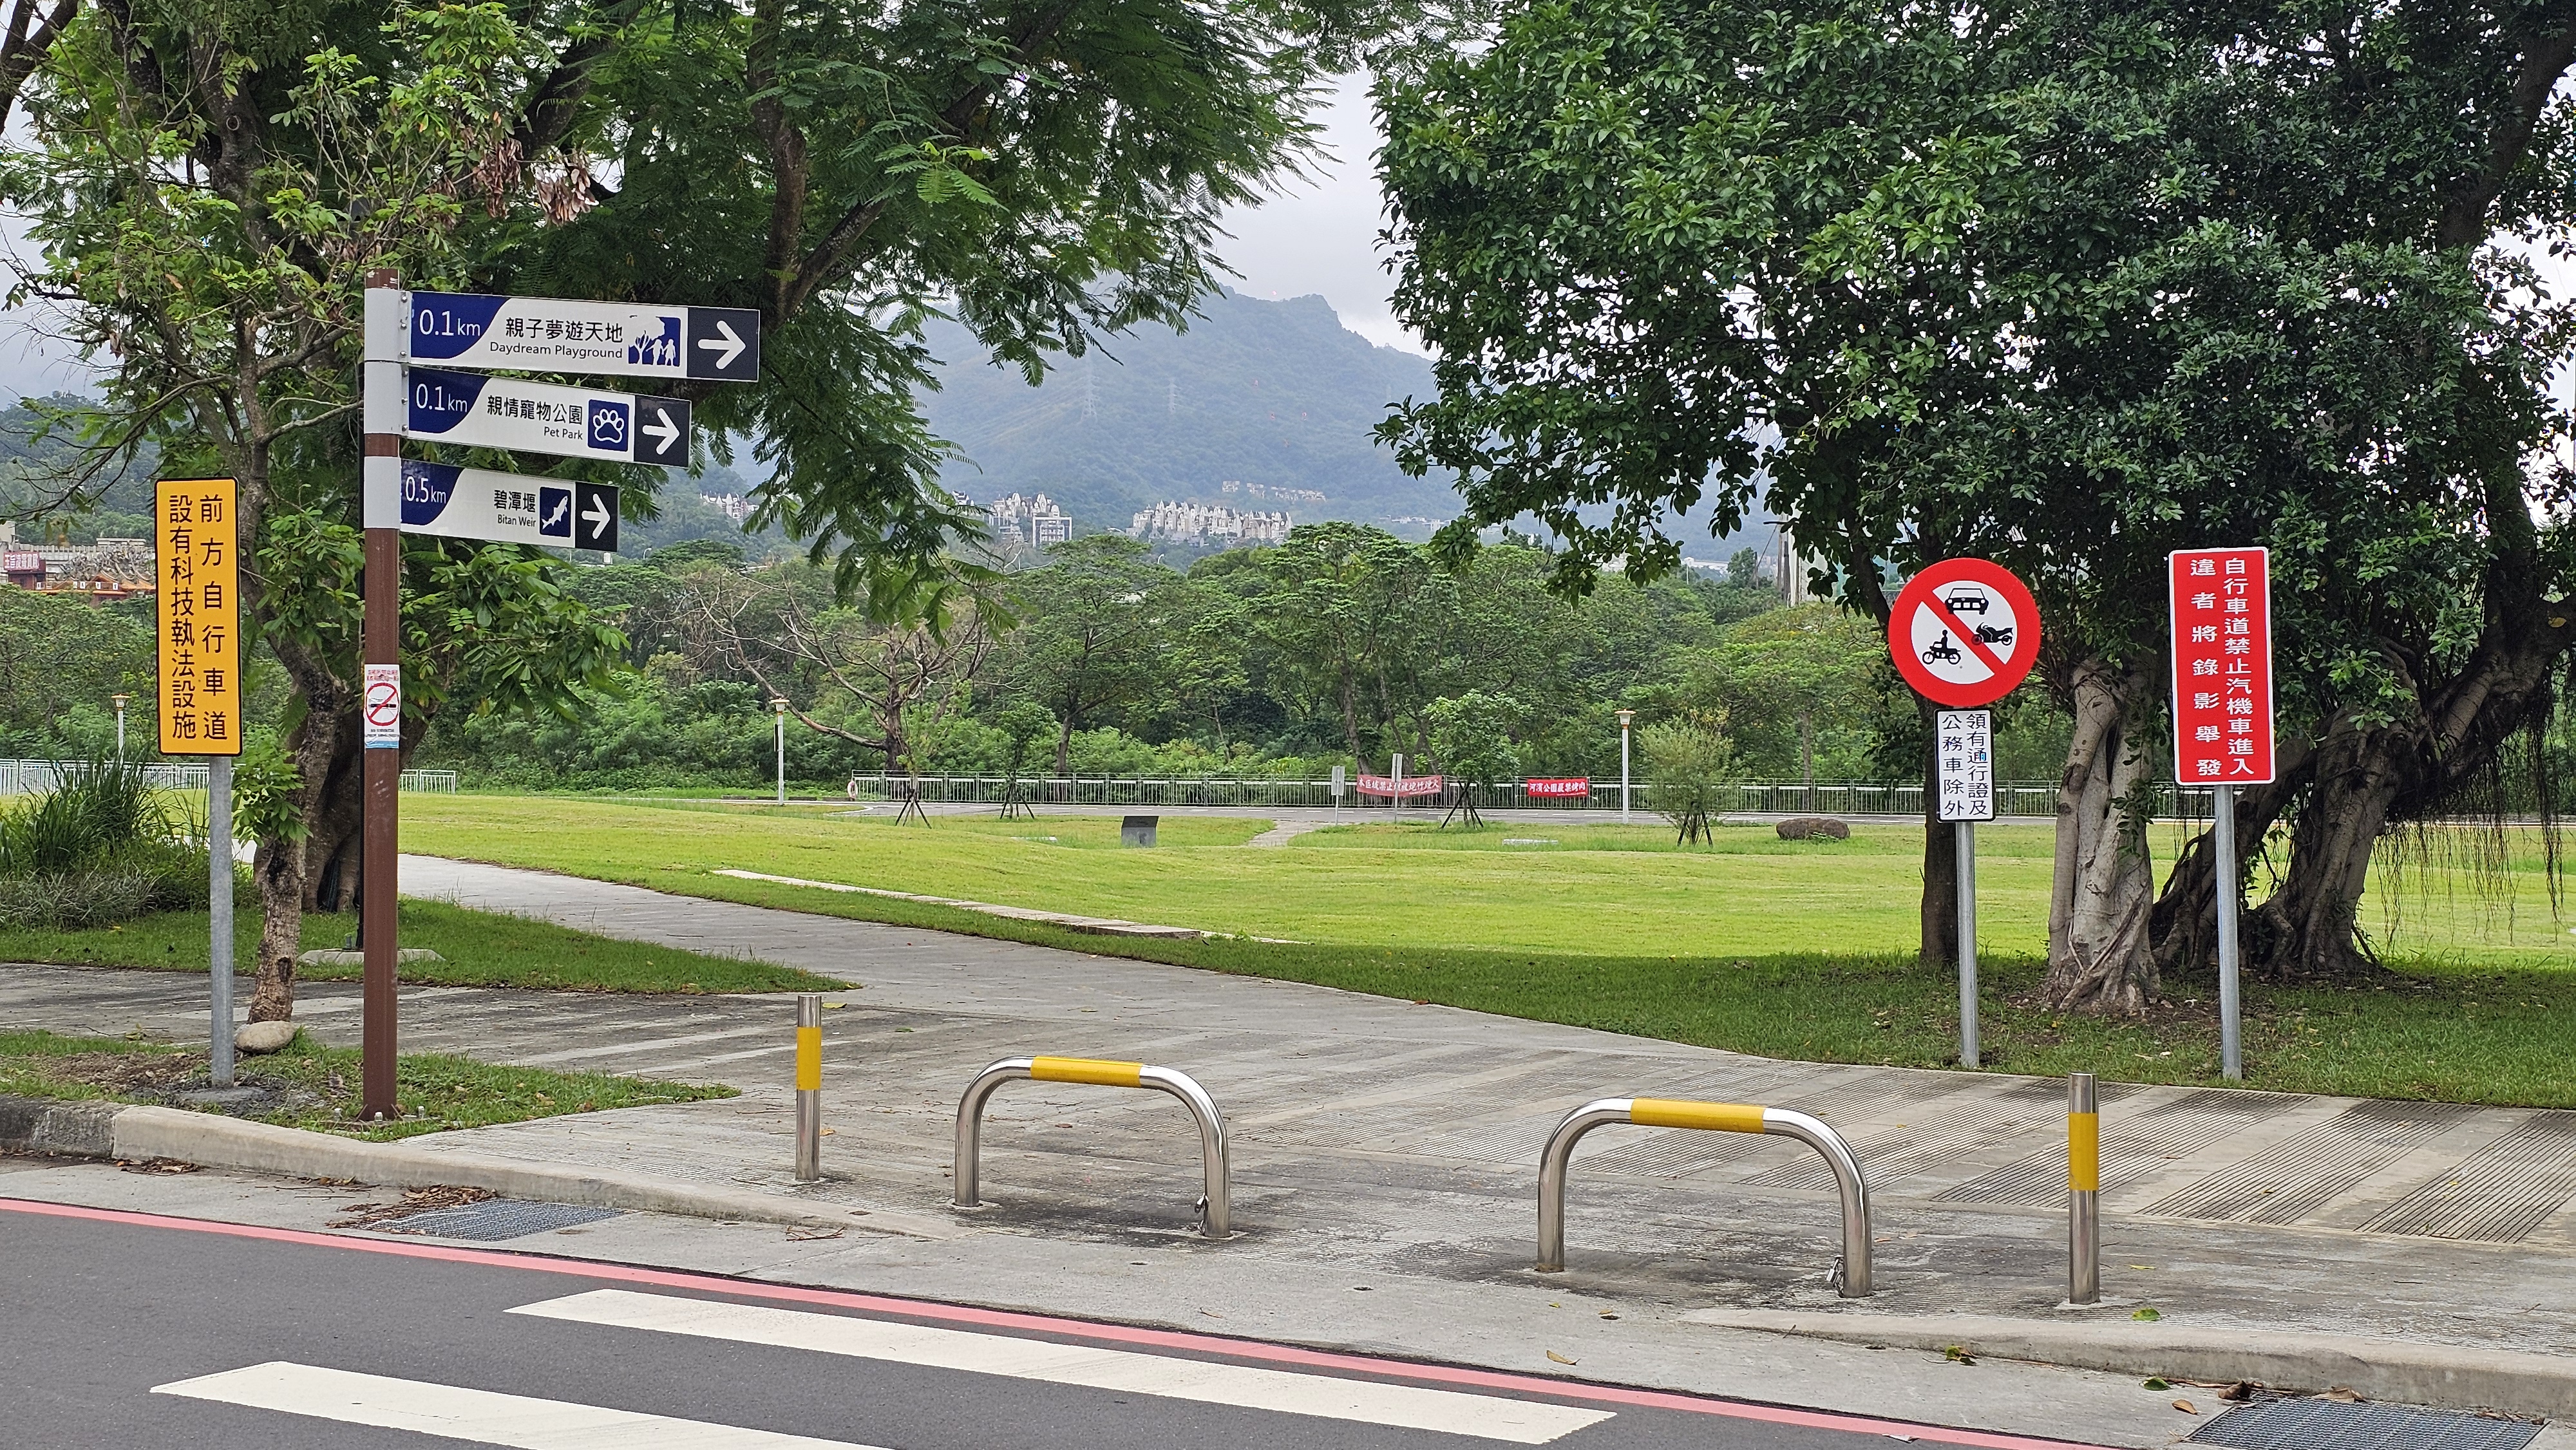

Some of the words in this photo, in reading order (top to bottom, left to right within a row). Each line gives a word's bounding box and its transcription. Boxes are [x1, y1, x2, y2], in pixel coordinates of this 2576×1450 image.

[490, 342, 551, 355] Daydream
[555, 345, 623, 359] Playground
[506, 317, 623, 343] 親子夢遊天地
[488, 395, 583, 425] 親情寵物公園
[544, 427, 559, 438] Pet
[562, 428, 583, 440] Park
[494, 489, 536, 513] 碧潭堰
[498, 514, 516, 525] Bitan
[519, 516, 536, 527] Weir
[169, 494, 196, 739] 設有科技執法設施
[200, 494, 227, 740] 前方自行車道
[2190, 559, 2222, 776] 違者將錄影舉發
[2223, 558, 2254, 775] 自行車道禁止汽機車進入
[1942, 714, 1965, 816] 公務車除外
[1965, 713, 1989, 816] 領有通行證及
